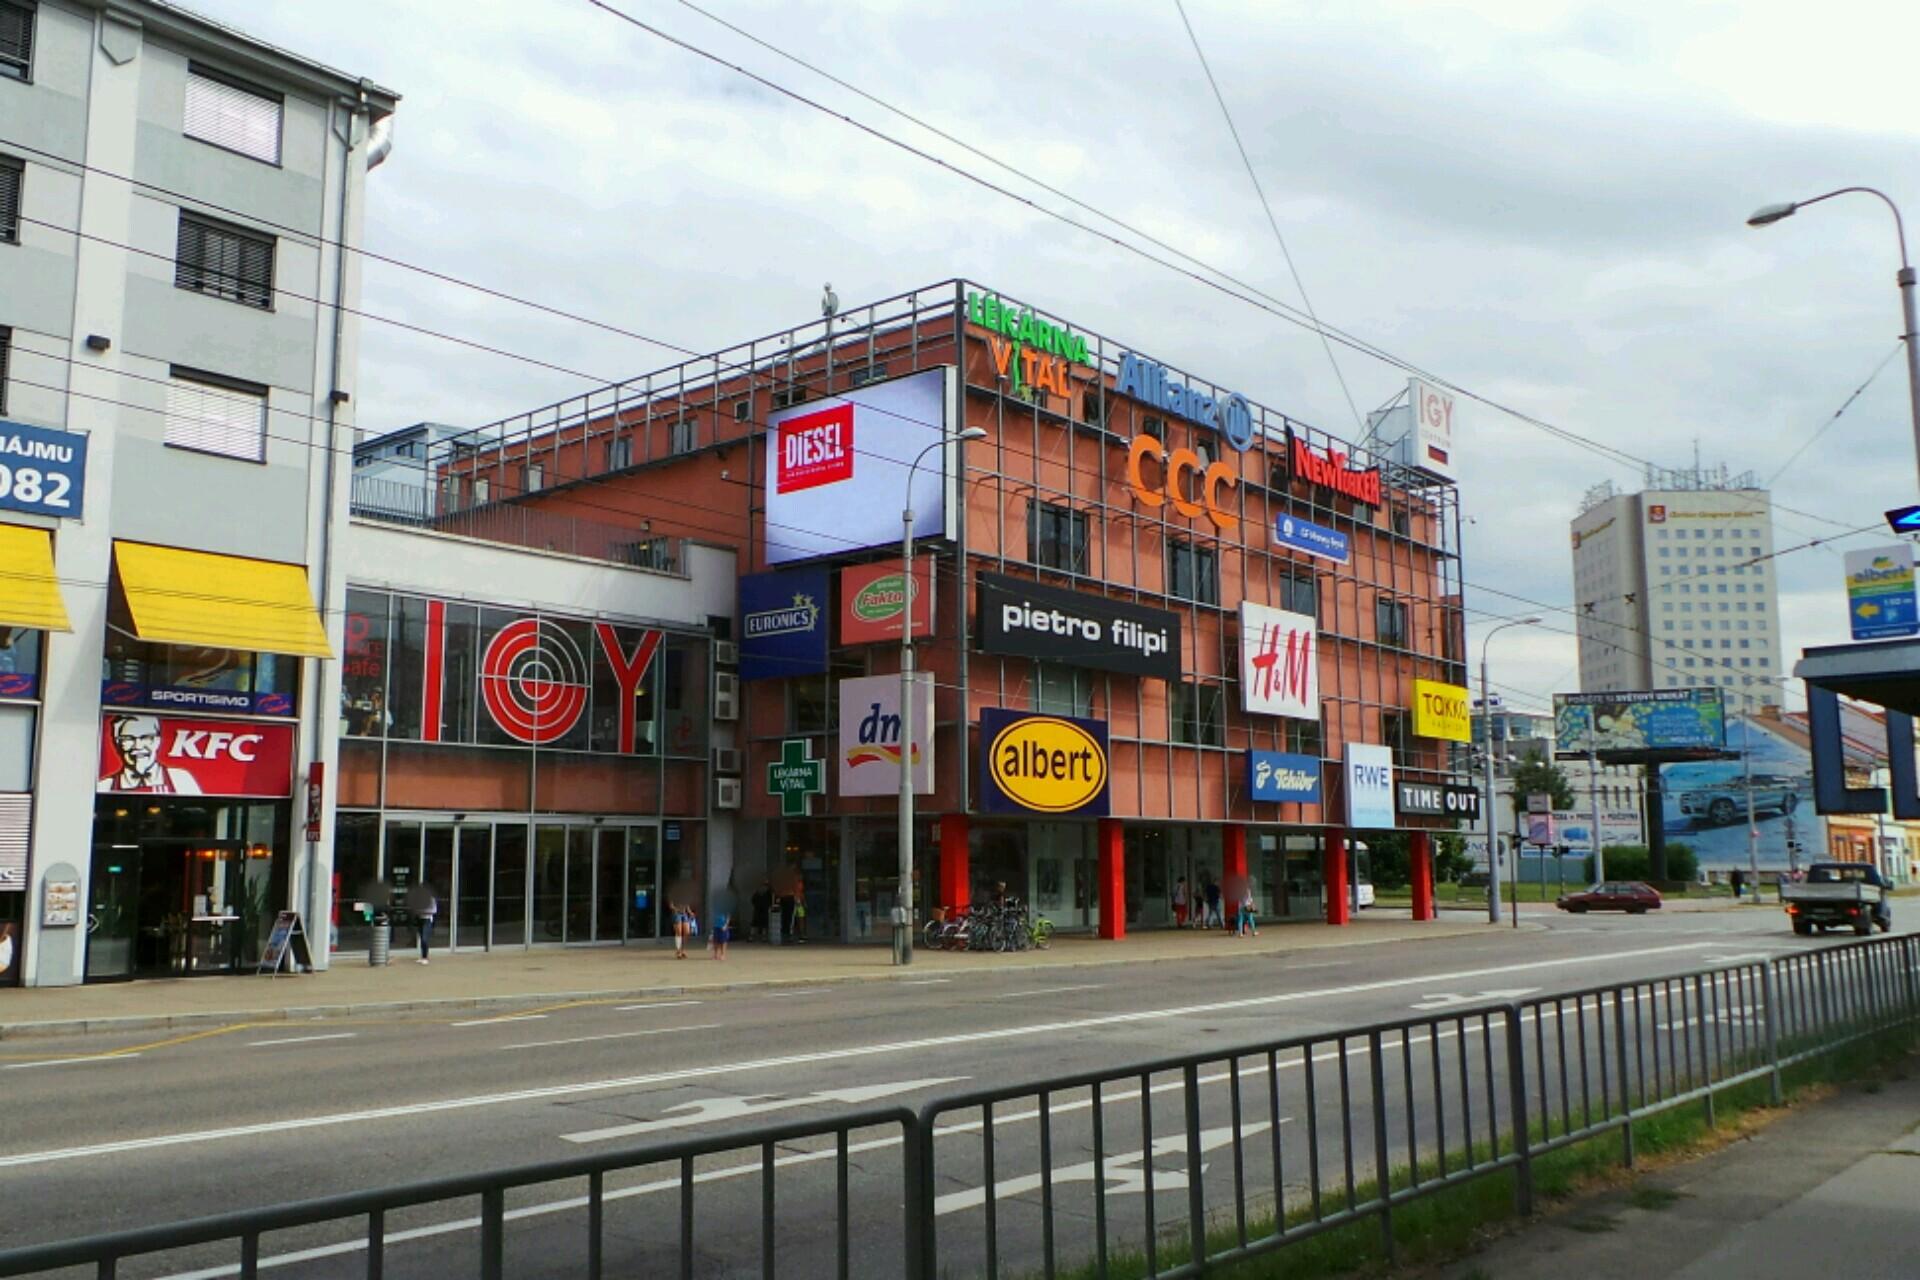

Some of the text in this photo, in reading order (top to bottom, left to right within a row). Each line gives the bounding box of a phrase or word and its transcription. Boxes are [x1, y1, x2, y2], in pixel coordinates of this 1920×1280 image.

[967, 290, 1091, 366] LÉKÁRNA
[1114, 350, 1219, 431] Allianz
[1127, 434, 1239, 530] CCC
[749, 608, 810, 632] EURONICS
[1002, 601, 1168, 657] pietro filipi
[1251, 621, 1311, 708] H&M
[151, 690, 250, 706] SPORTISIMO
[167, 729, 262, 761] KFC
[1002, 740, 1093, 783] albert
[1273, 767, 1318, 792] Tchibo
[1354, 763, 1390, 788] RWE
[1403, 788, 1477, 812] TIME OUT
